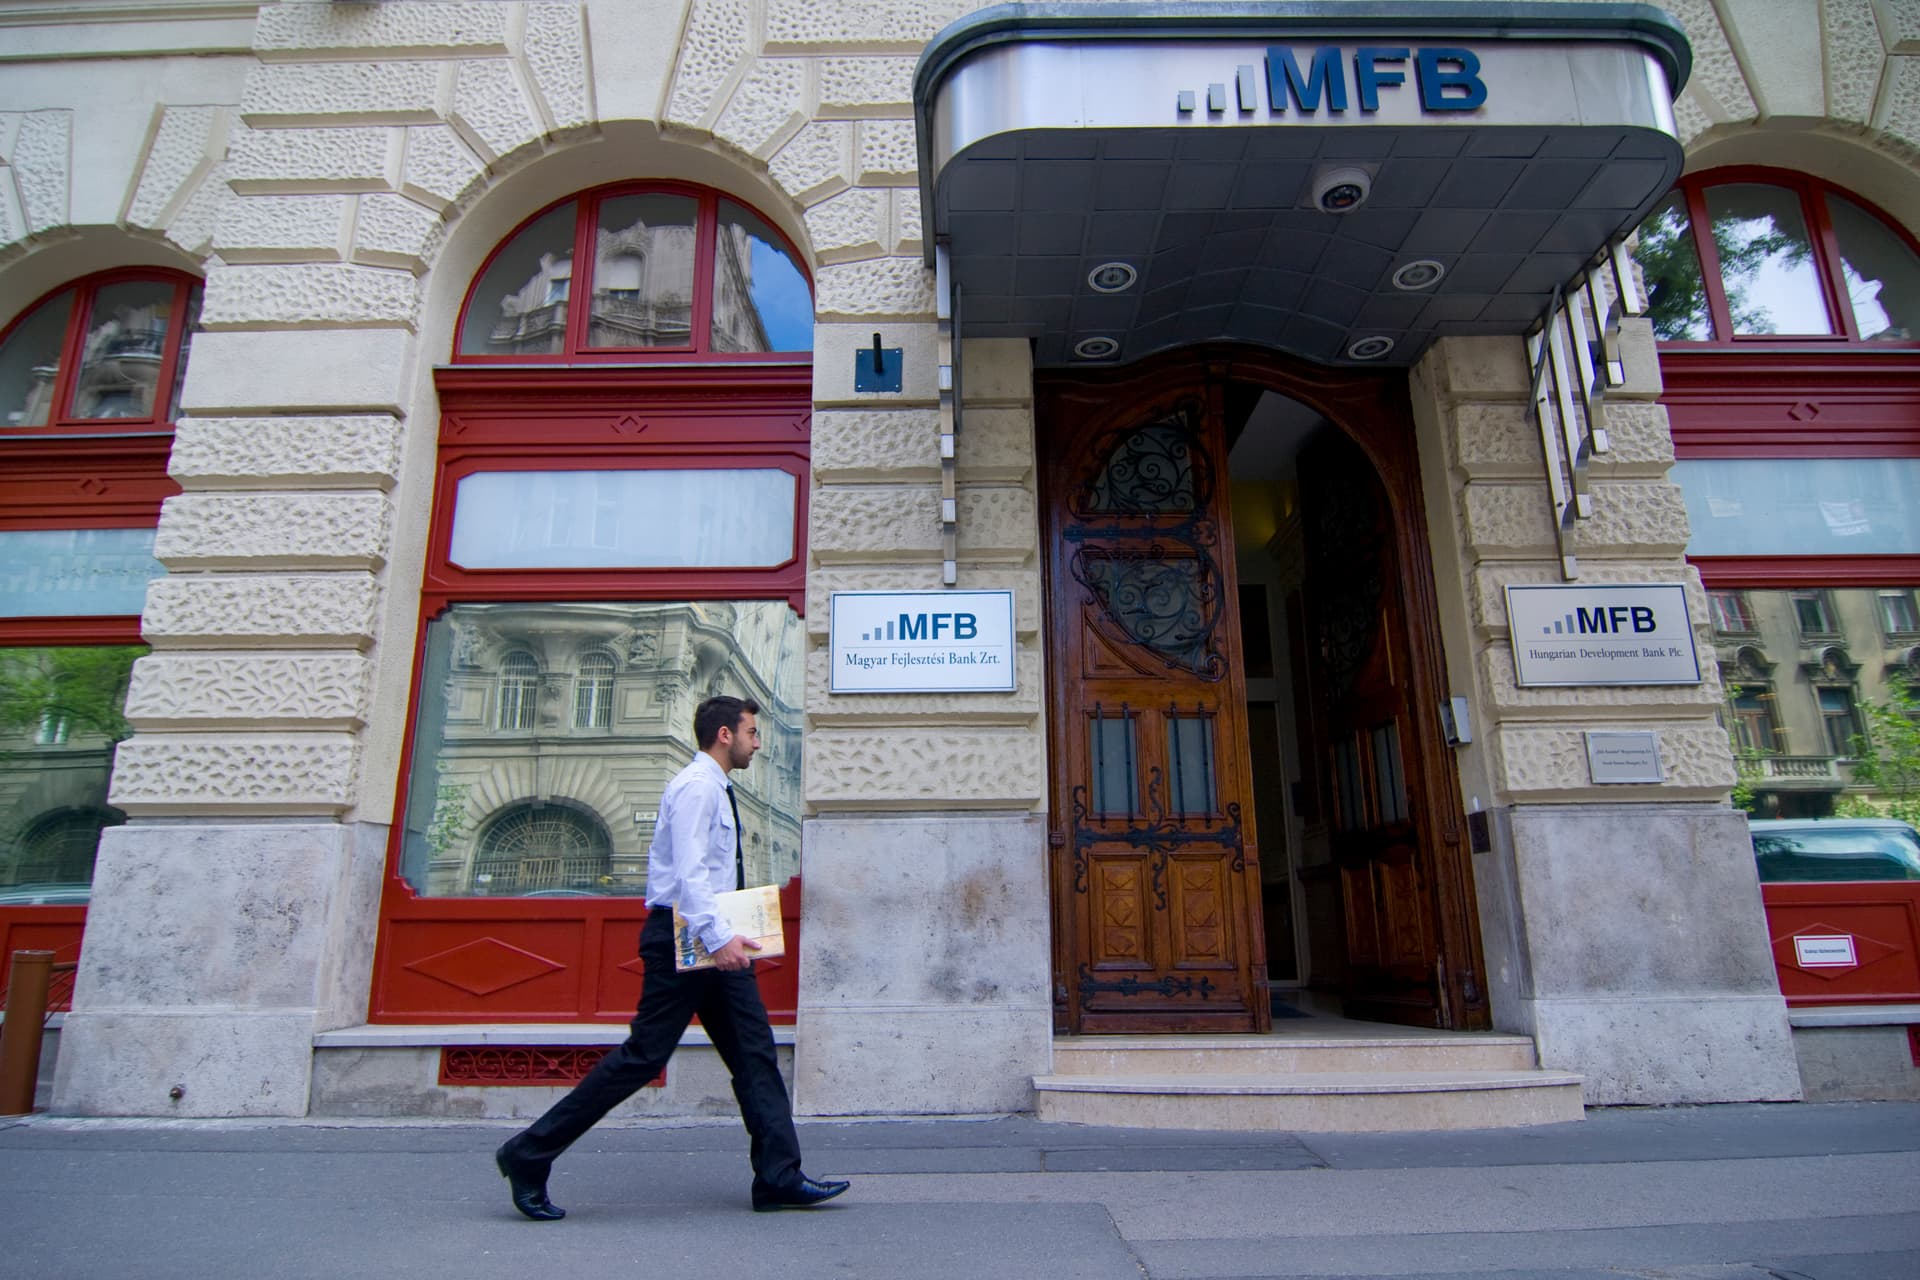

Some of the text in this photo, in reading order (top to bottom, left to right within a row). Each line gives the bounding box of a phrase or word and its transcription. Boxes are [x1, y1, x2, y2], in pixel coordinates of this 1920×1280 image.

[1265, 46, 1488, 112] MFB
[899, 613, 978, 640] MFB
[1576, 606, 1656, 634] MFB
[846, 651, 1001, 669] Magyar Fejlesztési Bank Zrt.
[1530, 647, 1684, 661] Hungarian Development Bank Plc.
